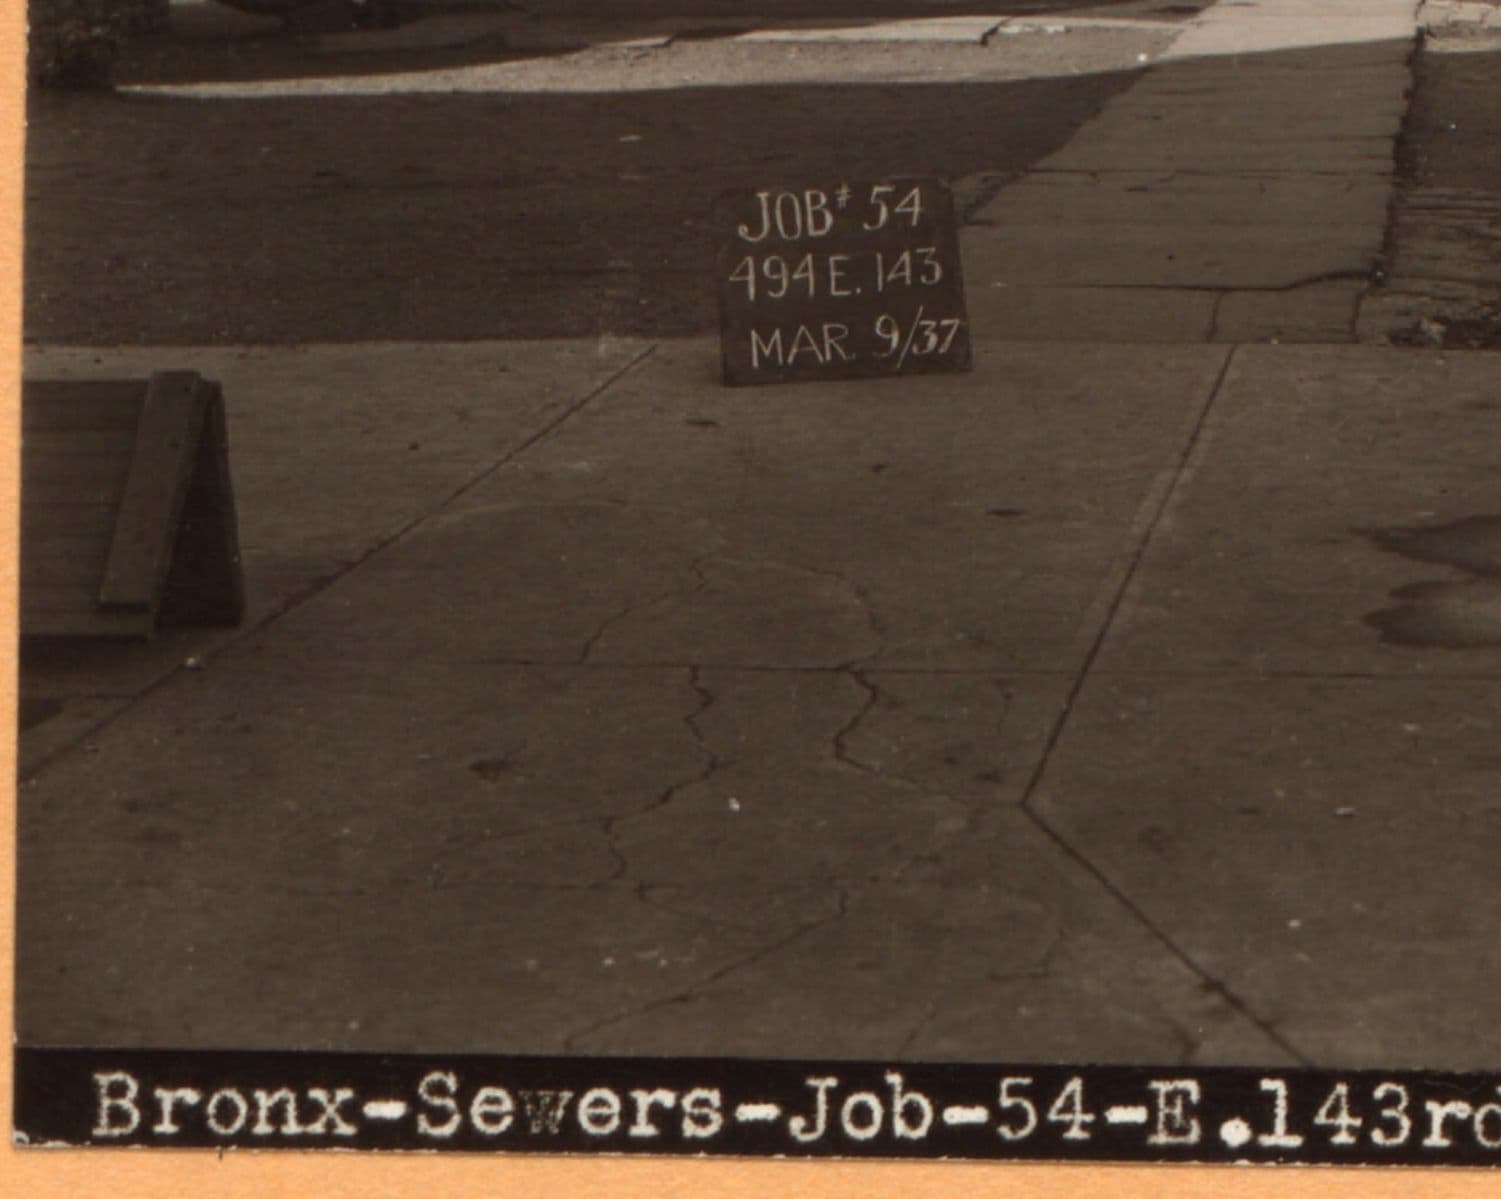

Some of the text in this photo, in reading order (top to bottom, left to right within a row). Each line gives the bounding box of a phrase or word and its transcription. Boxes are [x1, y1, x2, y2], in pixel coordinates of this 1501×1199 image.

[863, 184, 923, 230] 54
[875, 247, 943, 293] 143
[873, 304, 961, 369] 9/37
